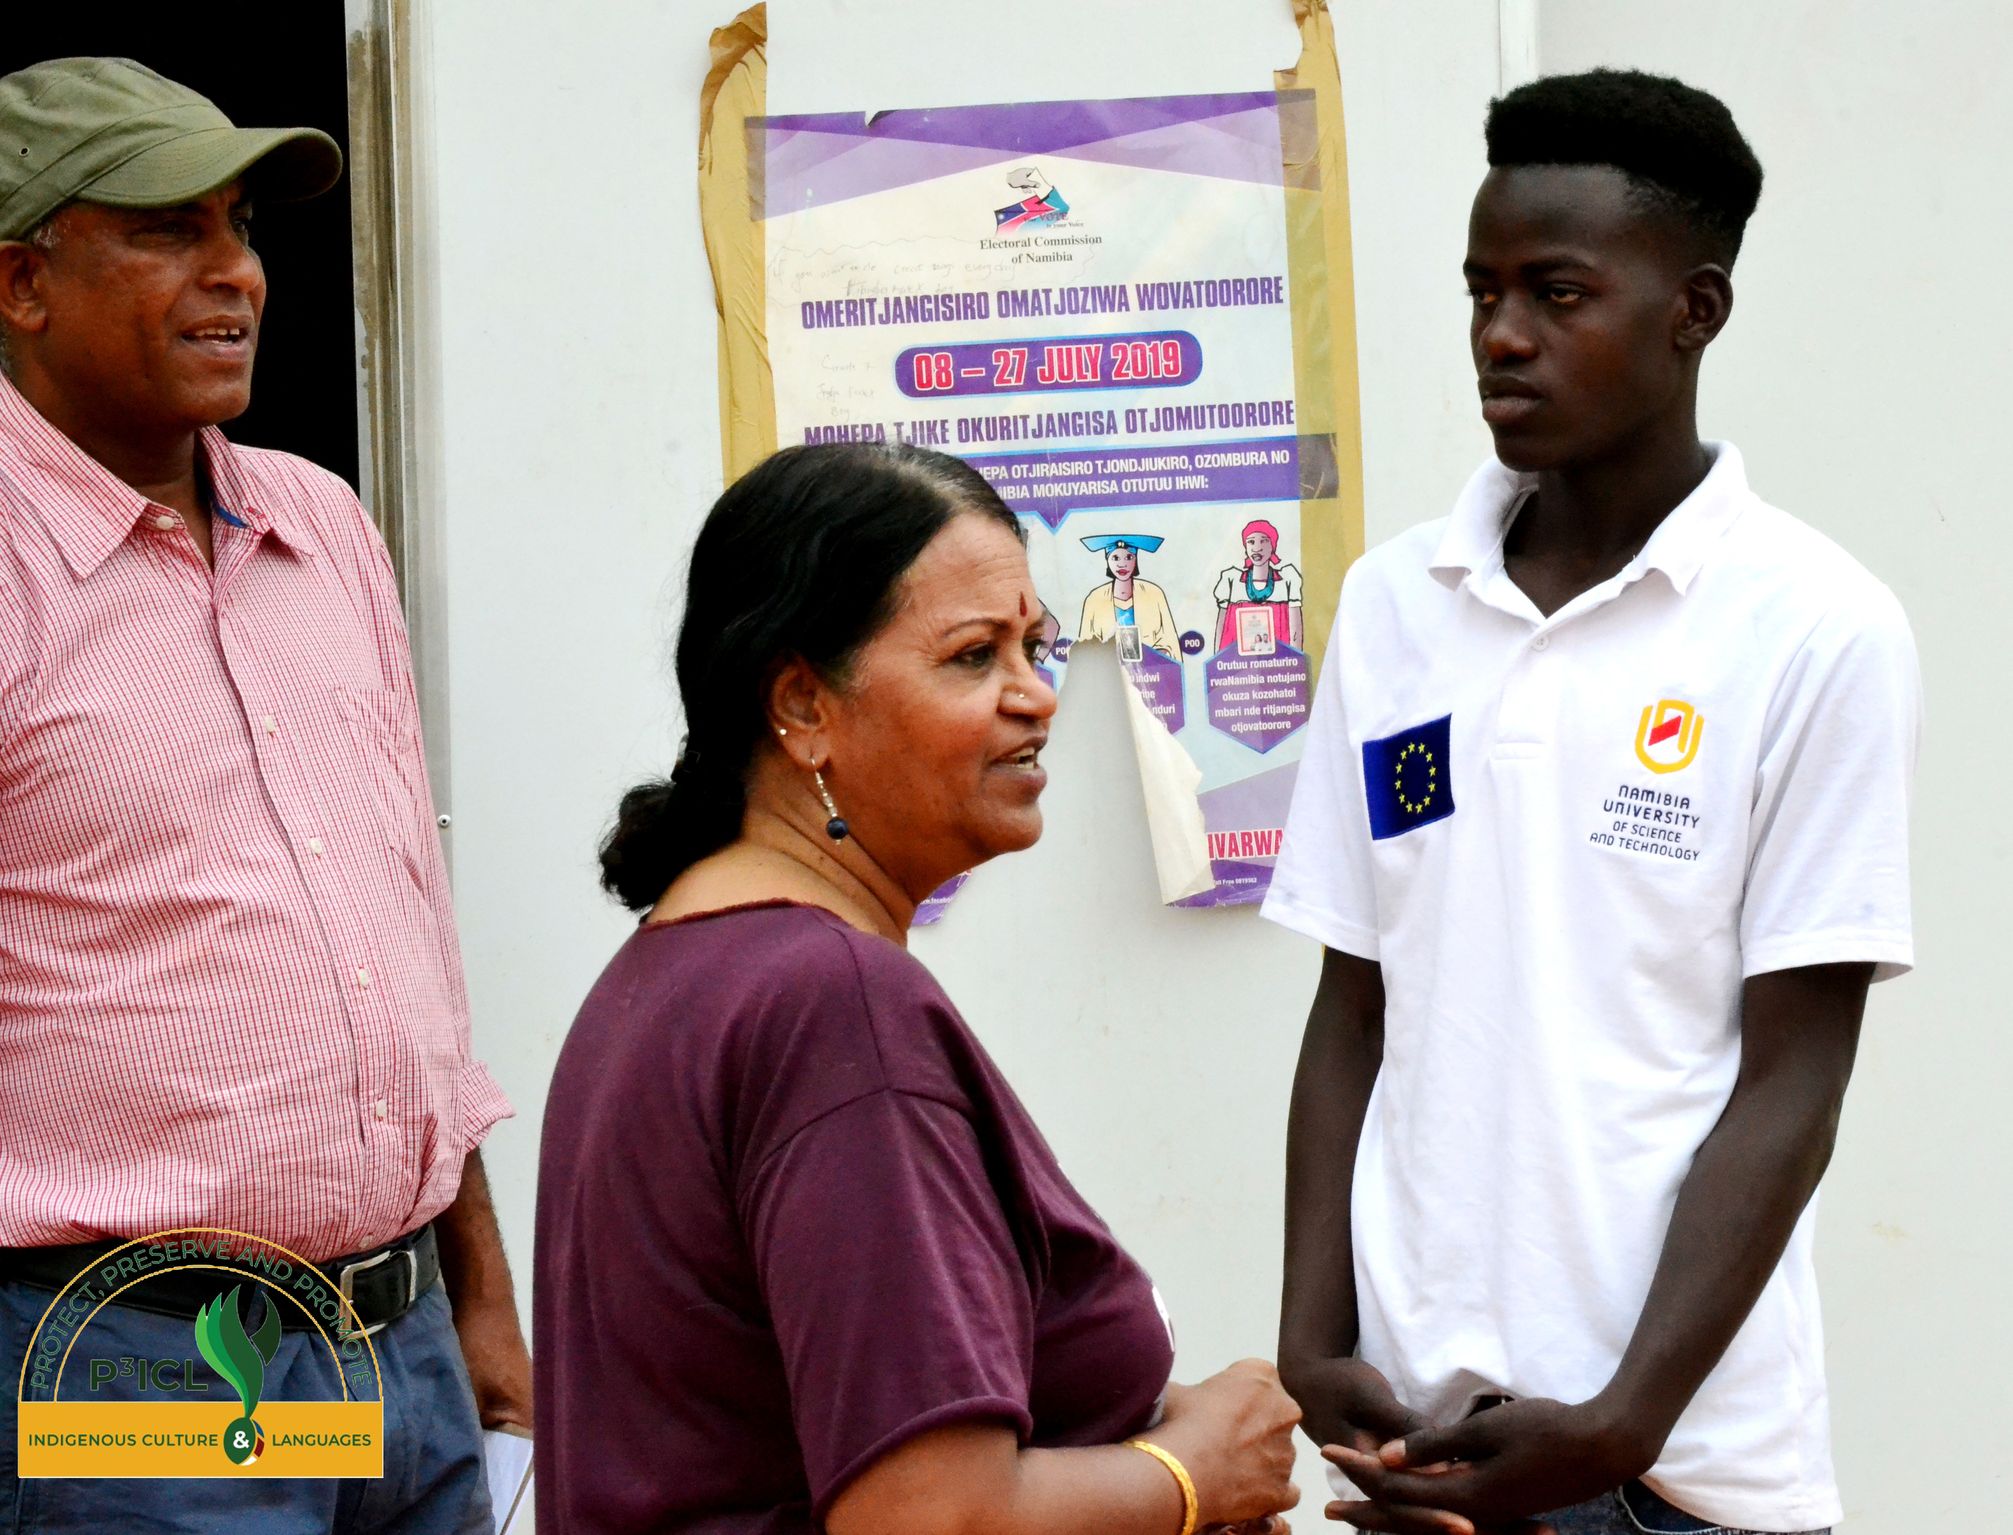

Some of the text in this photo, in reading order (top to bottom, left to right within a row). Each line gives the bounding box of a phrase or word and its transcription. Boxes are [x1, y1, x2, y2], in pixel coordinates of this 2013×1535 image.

[980, 234, 1103, 250] Electoral Commission
[1011, 251, 1073, 264] of Namibia
[1136, 275, 1284, 312] WOVATOORORE
[913, 352, 953, 391] 08
[993, 346, 1029, 387] 27
[1037, 343, 1102, 384] JULY
[1110, 339, 1182, 380] 2019
[804, 422, 886, 448] MOHEPA
[956, 408, 1119, 445] OKURITJANGISA
[1124, 400, 1295, 437] OTJOMUTOORORE
[1011, 459, 1093, 479] OTJIRAISIRO
[1194, 452, 1267, 469] OZOMBURA
[1270, 449, 1290, 464] NO
[1033, 478, 1119, 499] MOKUYARISA
[1121, 476, 1173, 493] OTUTUU
[1175, 475, 1209, 490] IHWI:
[1184, 638, 1200, 649] POO
[1216, 656, 1298, 671] Orutuu romaturiro
[1210, 672, 1306, 687] rwaNamibia notujano
[1222, 687, 1297, 701] okuza kozohatoi
[1215, 702, 1306, 718] mbari nde ritjangisa
[1231, 719, 1292, 733] otjovatoorore
[1618, 784, 1691, 810] NAMIBIA
[1603, 799, 1700, 829] UNIVERSITY
[1612, 820, 1683, 844] OF SCIENCE
[1589, 832, 1701, 861] AND TECHNOLOGY
